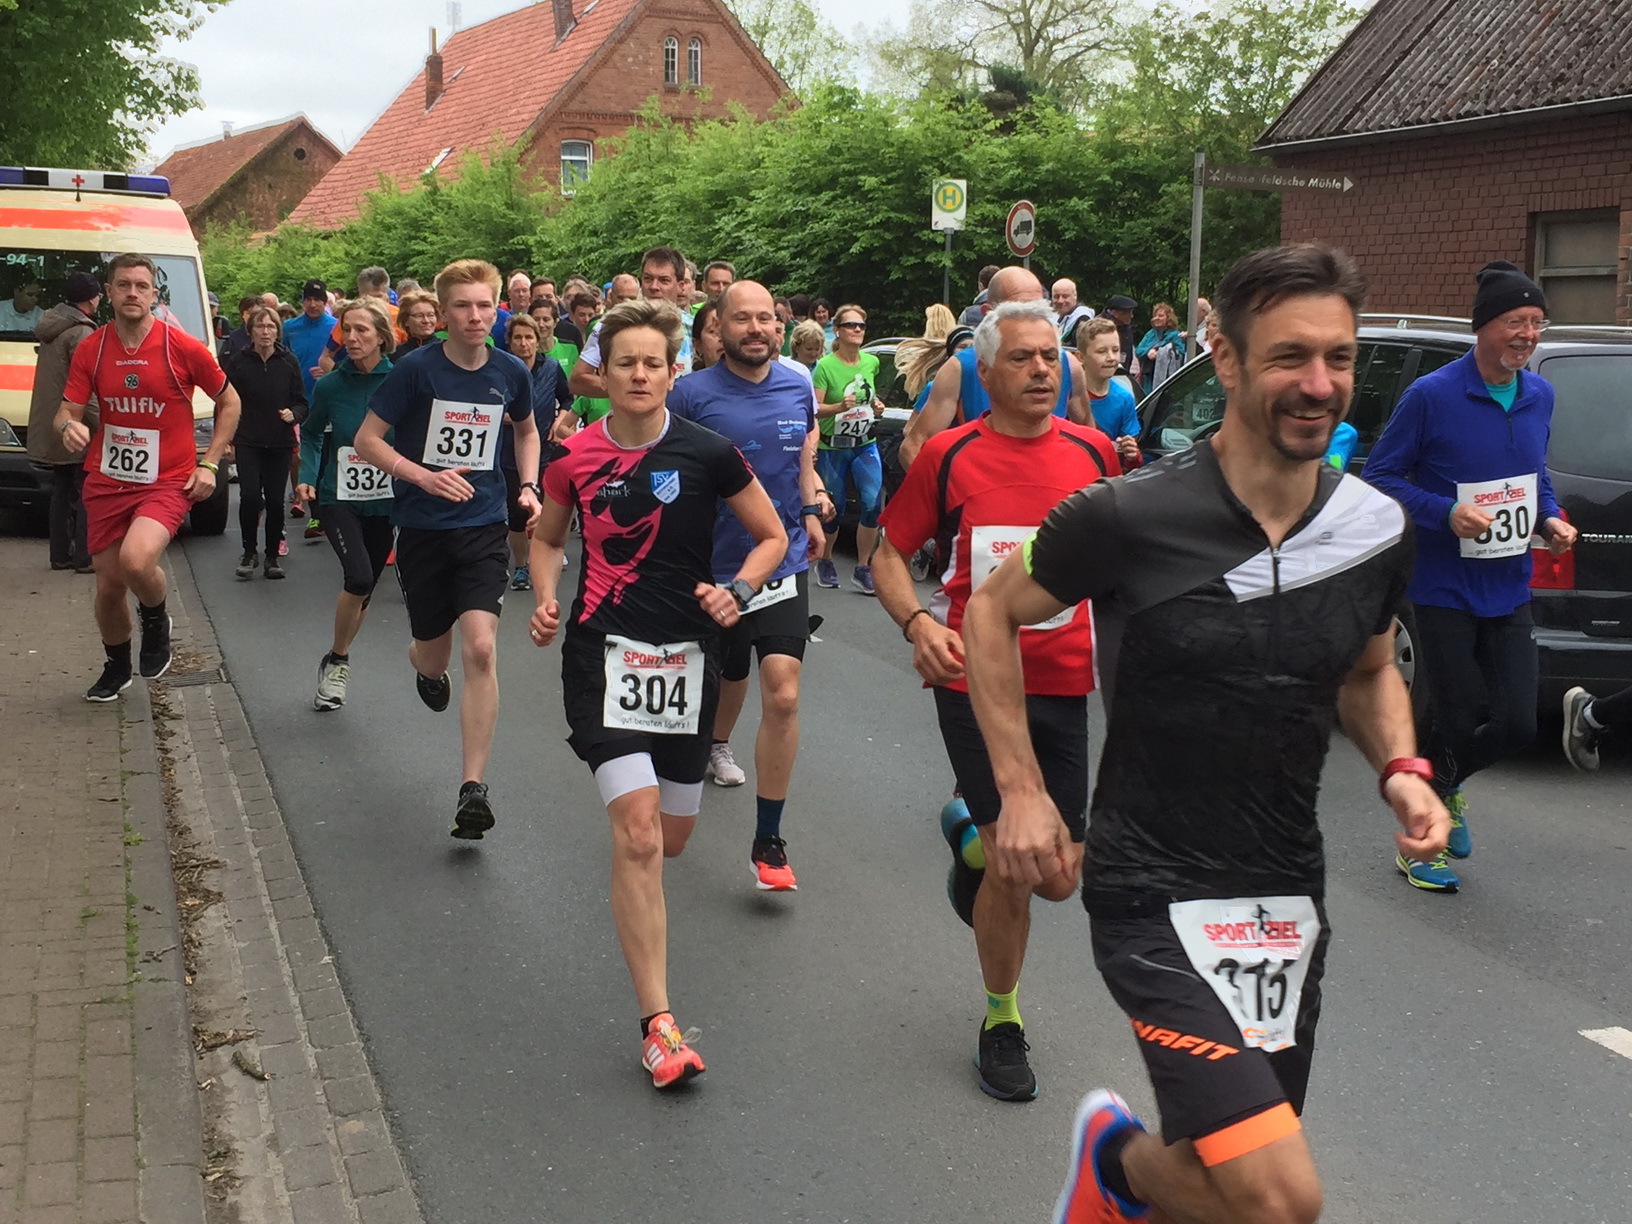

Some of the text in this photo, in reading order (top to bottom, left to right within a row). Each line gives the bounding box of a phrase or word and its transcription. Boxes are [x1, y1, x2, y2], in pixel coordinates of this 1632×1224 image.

[1307, 177, 1342, 190] Mühle
[942, 189, 957, 206] H
[444, 410, 472, 422] SPORT
[841, 419, 870, 436] 247
[437, 427, 487, 458] 331
[108, 446, 149, 473] 262
[346, 467, 388, 491] 332
[1473, 491, 1504, 504] SPORT
[991, 541, 1021, 554] SPO
[623, 650, 662, 665] SPORT
[619, 673, 688, 716] 304
[621, 716, 633, 726] gut
[634, 717, 663, 728] beraten
[1202, 920, 1257, 941] SPORT
